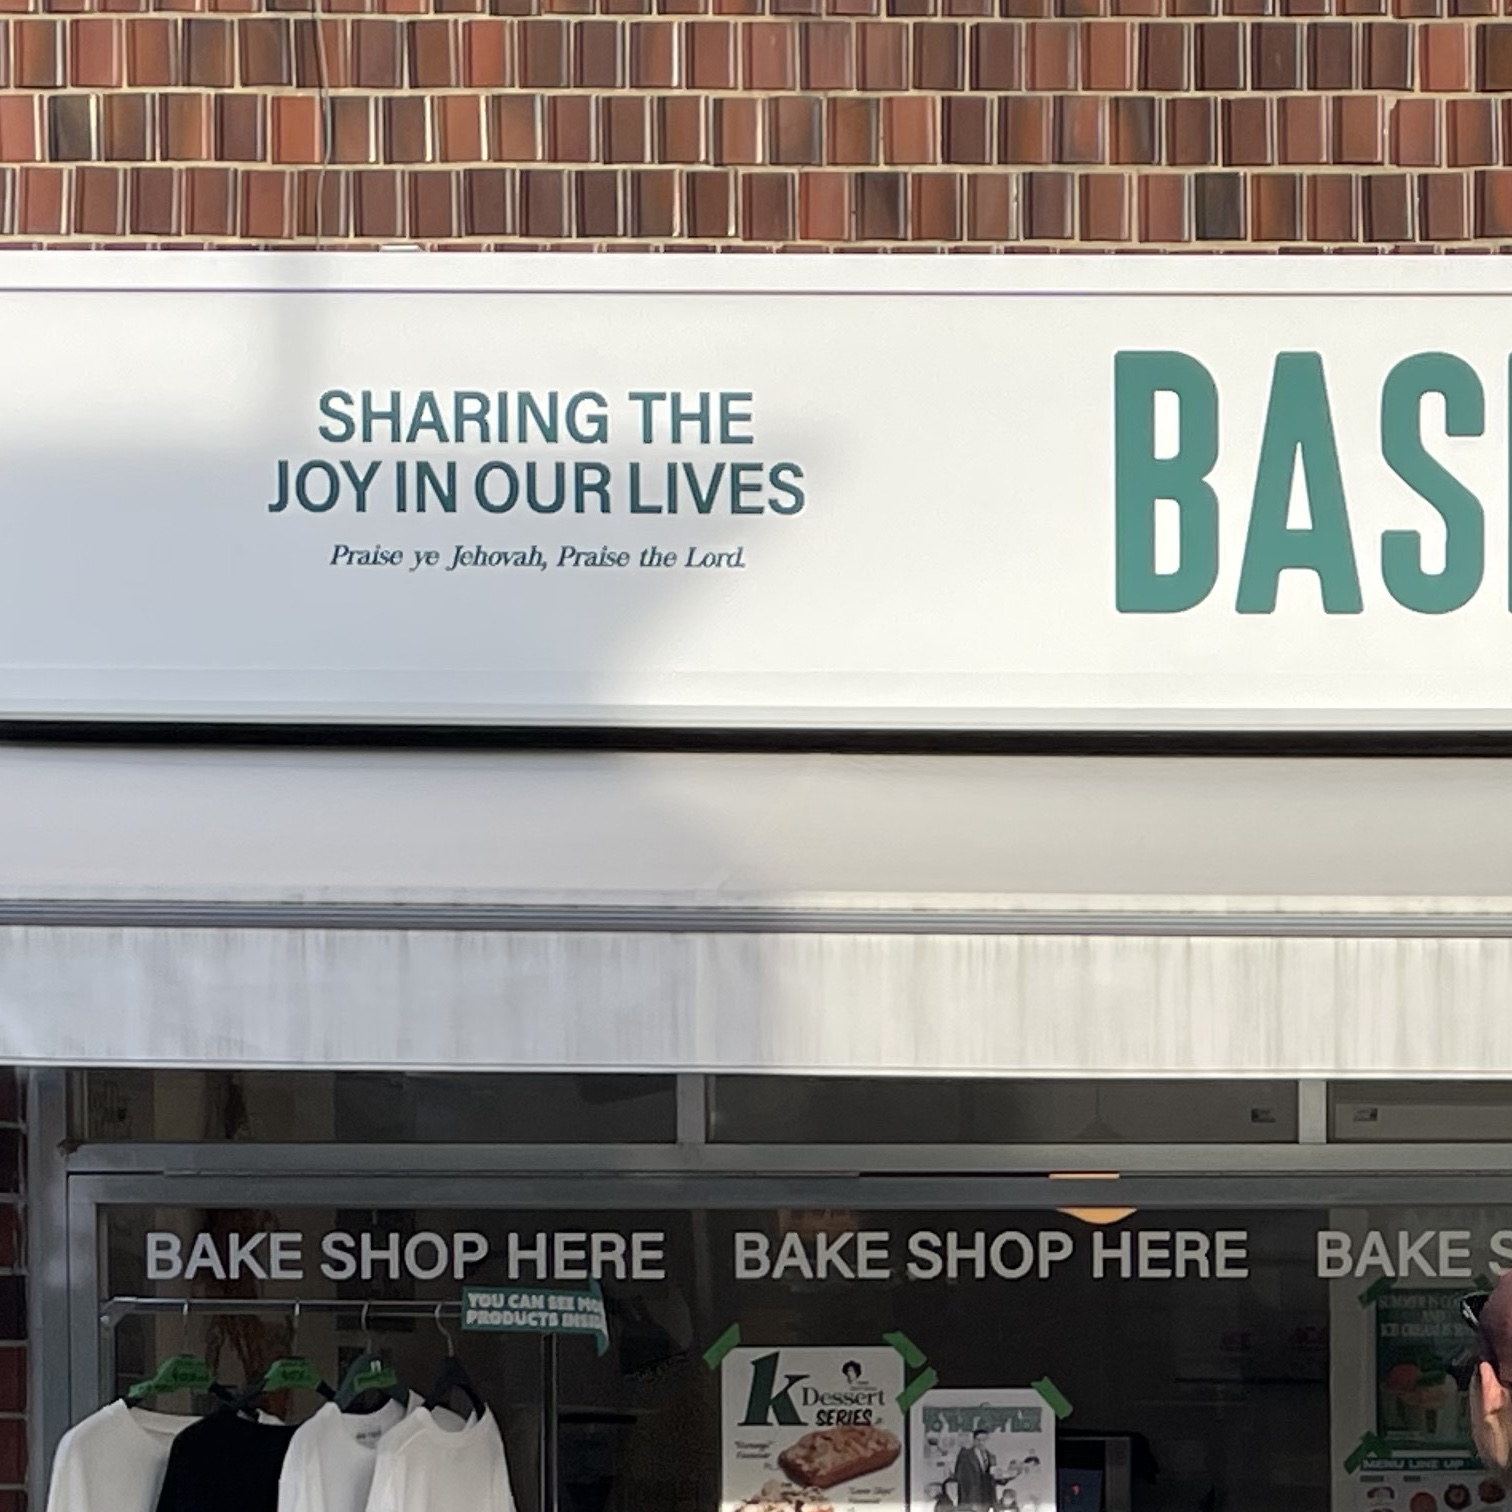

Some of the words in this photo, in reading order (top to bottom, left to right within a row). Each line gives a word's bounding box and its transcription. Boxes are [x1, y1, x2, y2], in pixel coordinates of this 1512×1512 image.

[318, 389, 609, 444] SHARING
[628, 391, 754, 445] THE
[268, 459, 382, 513] JOY
[396, 460, 456, 514] IN
[474, 460, 612, 515] OUR
[629, 461, 806, 516] LIVES
[329, 543, 404, 567] Praise
[409, 551, 440, 572] ye
[445, 544, 549, 573] Jehovah,
[556, 545, 630, 568] Praise
[639, 545, 677, 568] the
[685, 545, 746, 569] Lord.
[145, 1231, 303, 1280] BAKE
[320, 1231, 489, 1280] SHOP
[507, 1231, 666, 1280] HERE
[733, 1230, 891, 1280] BAKE
[906, 1230, 1074, 1280] SHOP
[1091, 1230, 1249, 1279] HERE
[1315, 1230, 1472, 1279] BAKE
[465, 1310, 559, 1328] PRODUCTS
[467, 1292, 505, 1309] YOU
[507, 1294, 545, 1310] CAN
[801, 1386, 886, 1406] Dessert
[815, 1408, 874, 1427] SERIES
